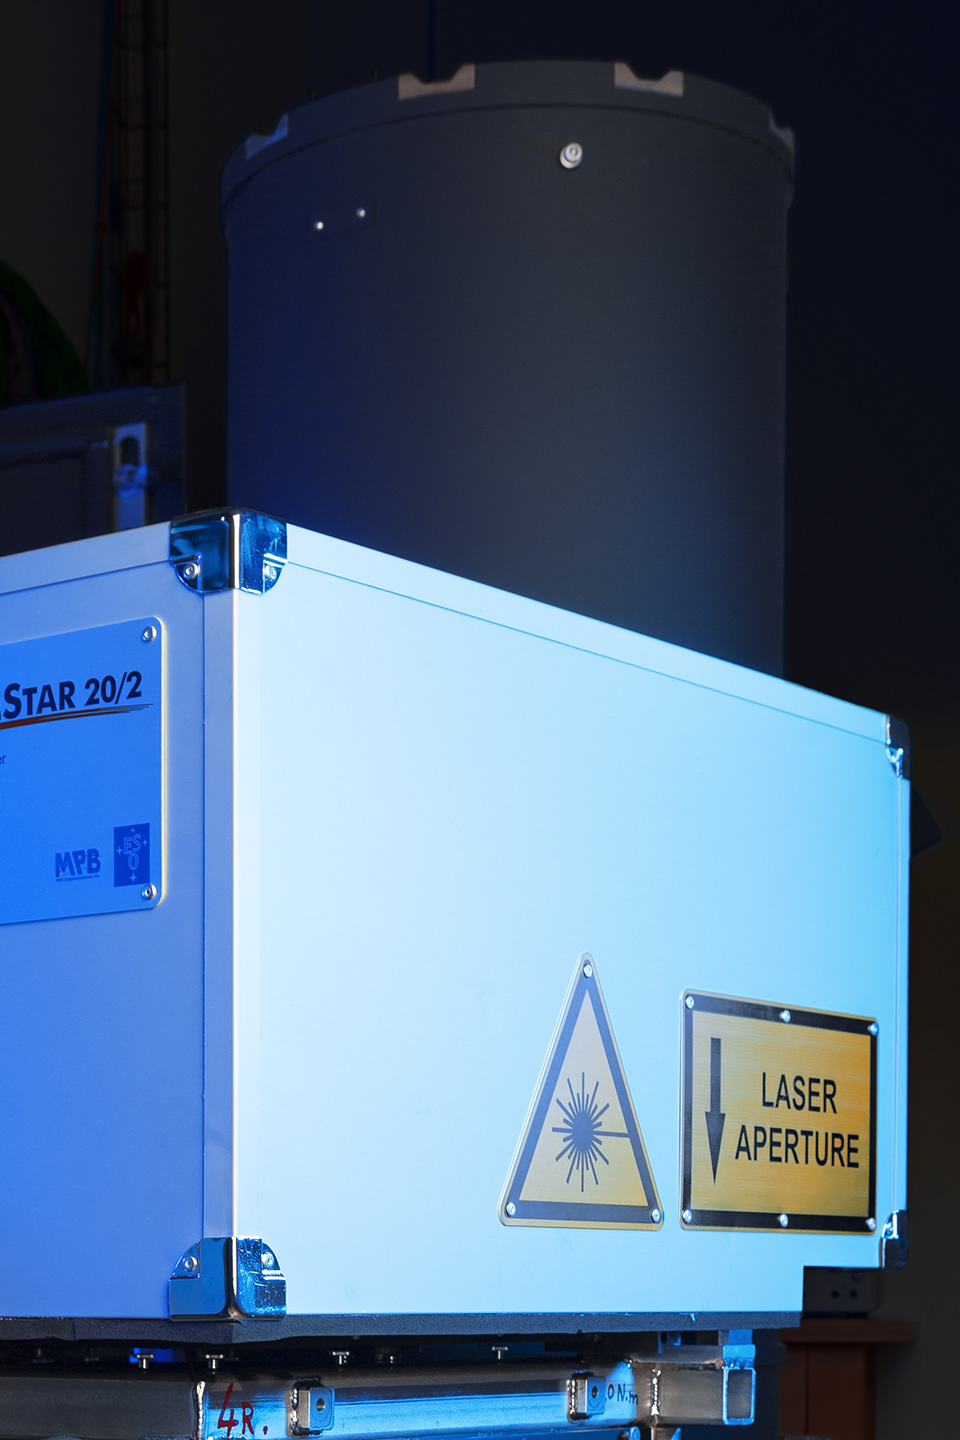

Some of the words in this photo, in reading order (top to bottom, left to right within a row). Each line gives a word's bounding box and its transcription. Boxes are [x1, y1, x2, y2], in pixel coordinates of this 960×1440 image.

[85, 670, 142, 706] 20/2
[55, 848, 101, 877] MPB
[761, 1072, 838, 1114] LASER
[735, 1124, 860, 1168] APERTURE
